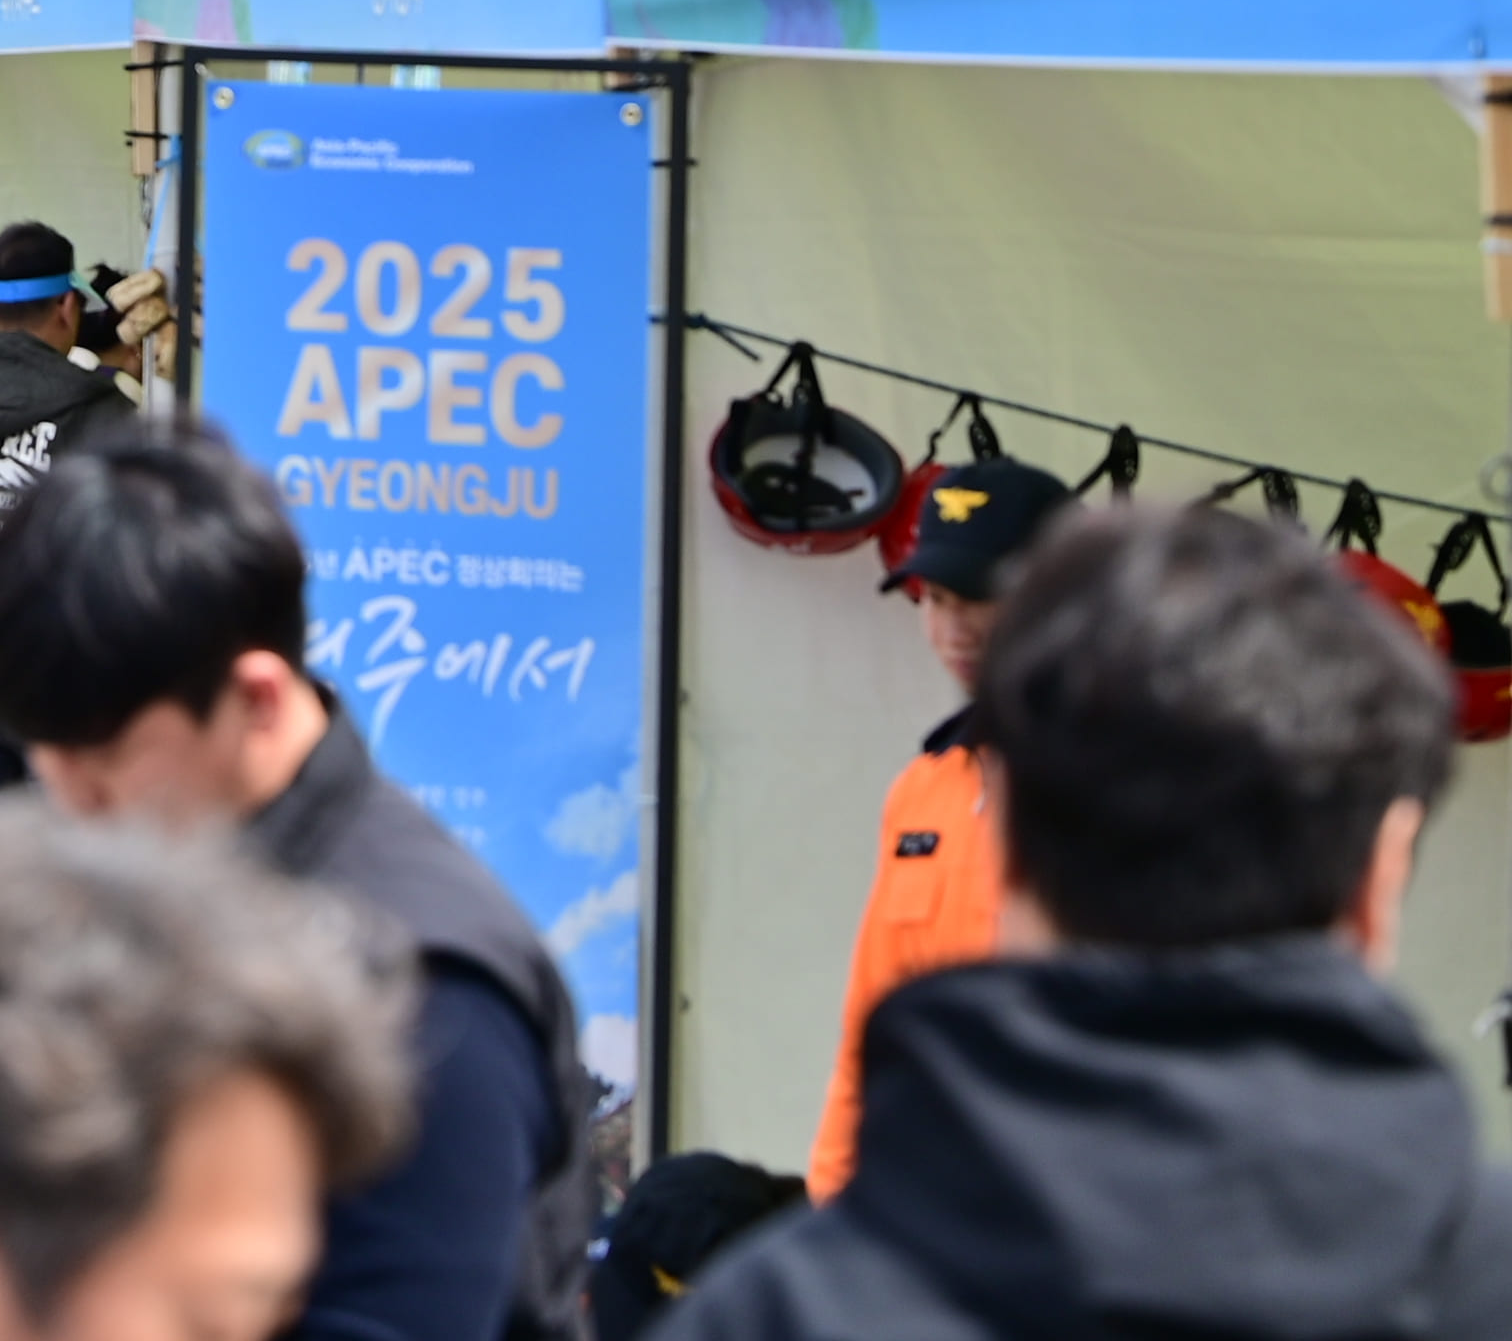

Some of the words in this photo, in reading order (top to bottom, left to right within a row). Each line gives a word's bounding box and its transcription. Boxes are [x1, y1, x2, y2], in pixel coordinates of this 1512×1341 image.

[285, 237, 567, 343] 2025
[275, 344, 566, 450] APEC
[275, 455, 560, 519] GYEONGJU
[342, 547, 452, 586] APEC
